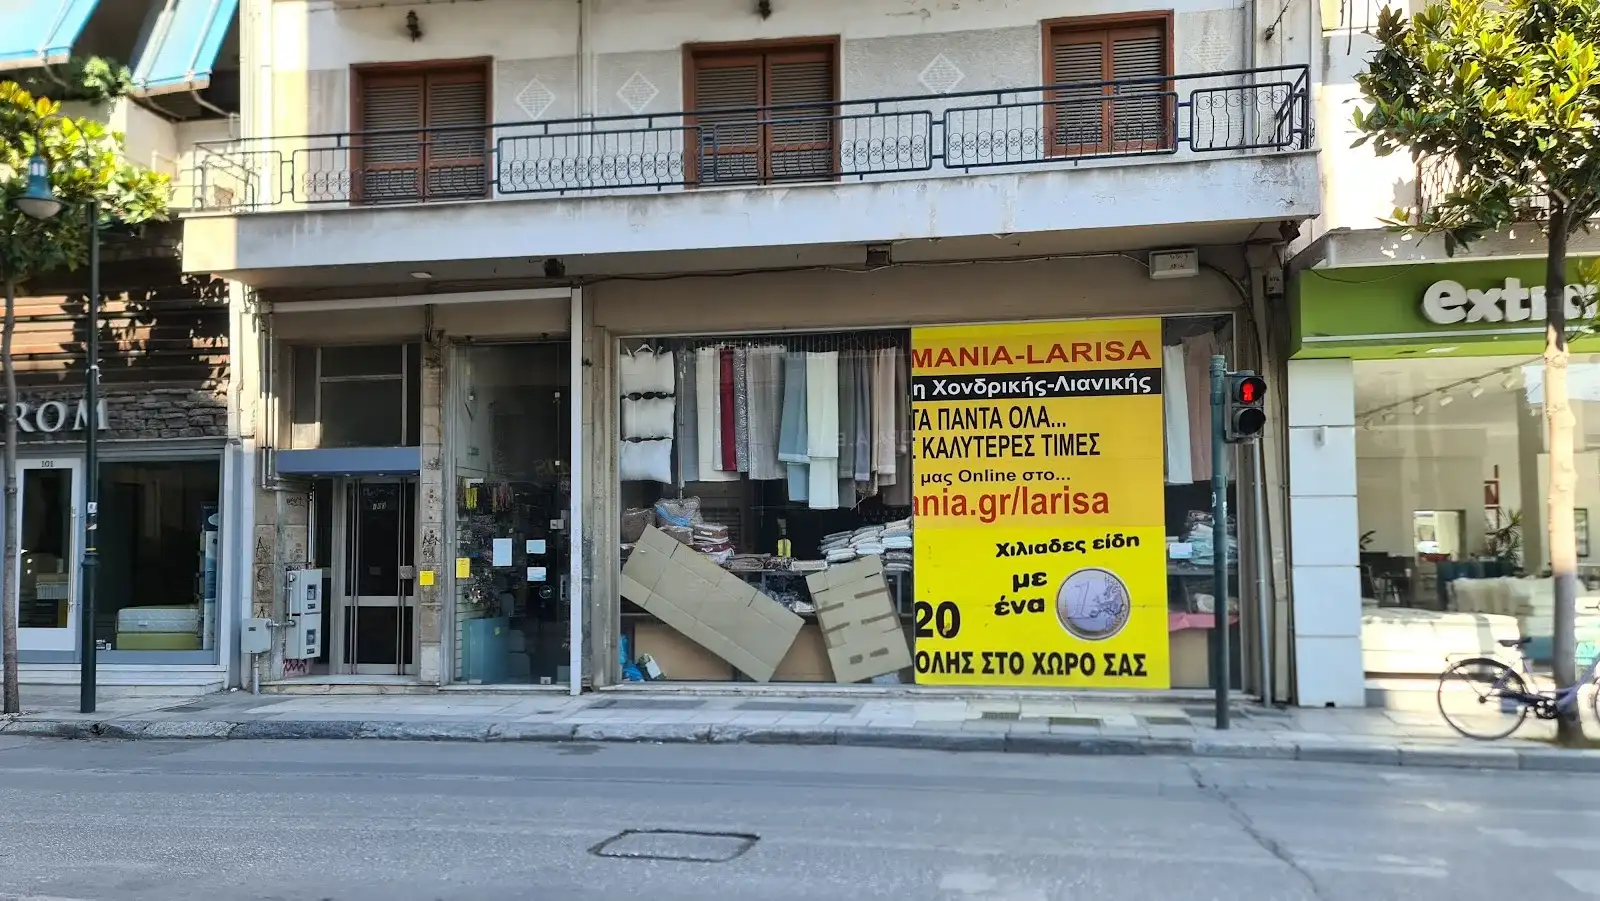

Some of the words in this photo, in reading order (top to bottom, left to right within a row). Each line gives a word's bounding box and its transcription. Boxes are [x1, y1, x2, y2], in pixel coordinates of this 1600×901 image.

[912, 340, 1152, 368] MANIA-LARISA
[932, 373, 1152, 397] Χονδρικής-Λιανικής
[938, 406, 1003, 431] ΠΑΝΤΑ
[1009, 405, 1067, 429] ΟΛΑ...
[922, 433, 1035, 459] ΚΑΛΥΤΕΡΕΣ
[1041, 432, 1101, 457] ΤΙΜΕΣ
[921, 471, 953, 487] μας
[958, 469, 1017, 482] Online
[1022, 470, 1071, 482] στο...
[1092, 533, 1140, 550] είδη
[1012, 571, 1048, 593] με
[994, 595, 1046, 616] ένα
[915, 601, 961, 639] 20
[915, 650, 975, 674] ΟΛΗΣ
[981, 650, 1025, 675] ΣΤΟ
[1032, 652, 1096, 676] ΧΩΡΟ
[1103, 653, 1148, 677] ΣΑΣ
